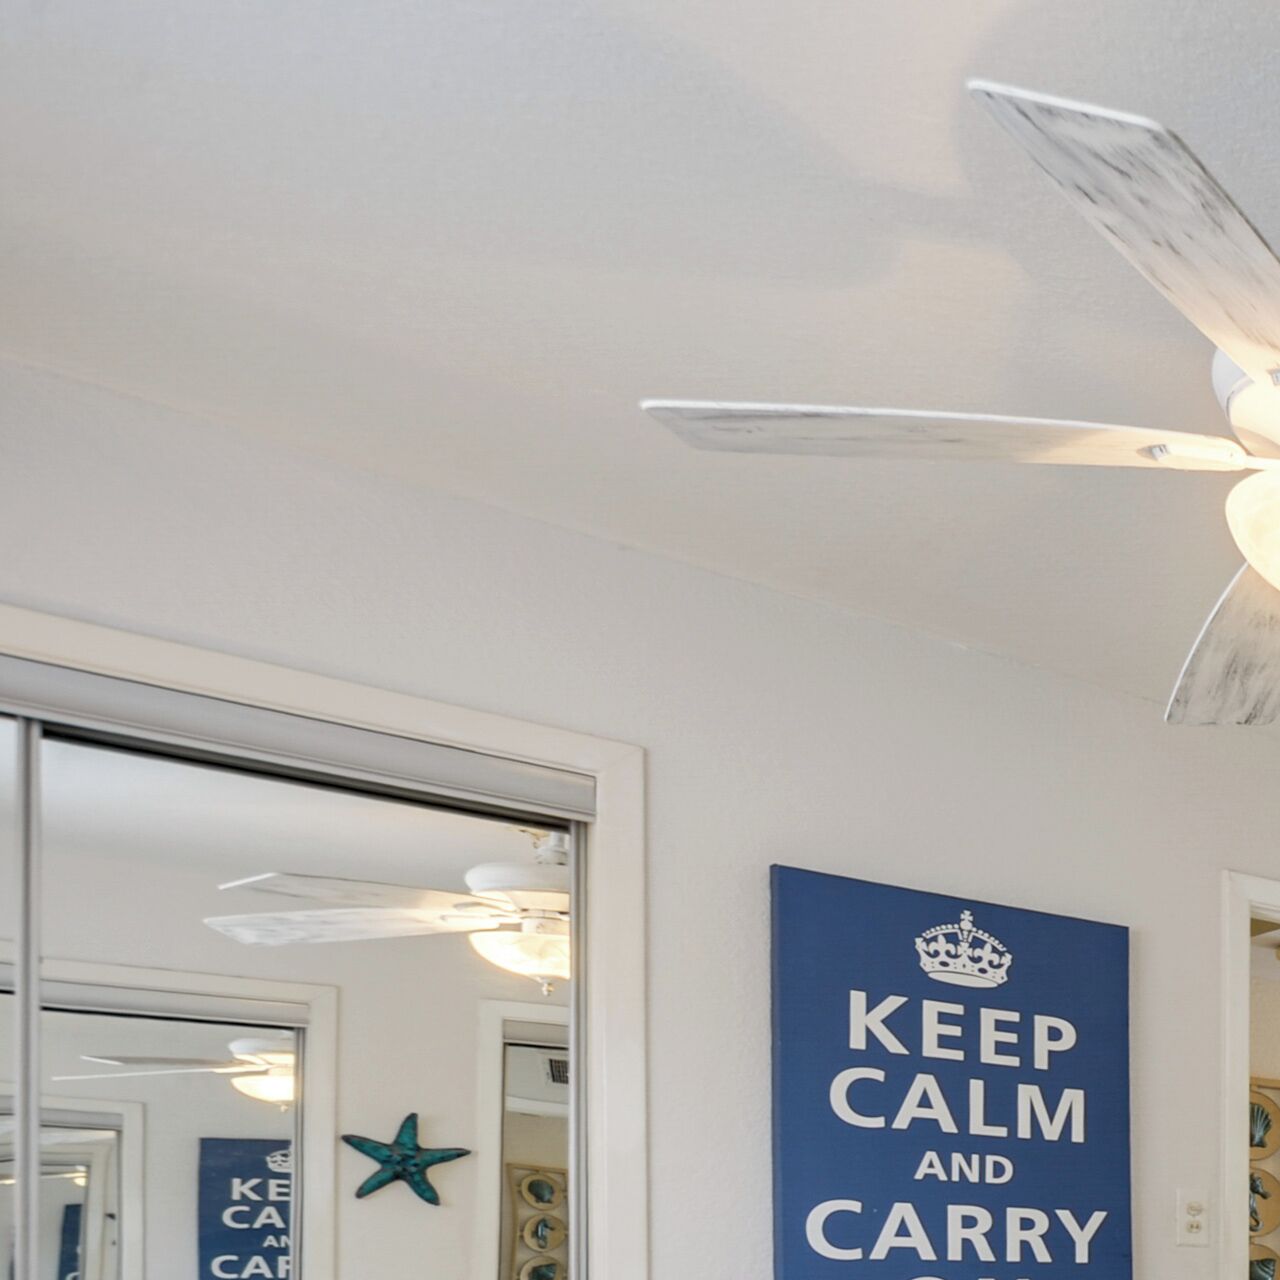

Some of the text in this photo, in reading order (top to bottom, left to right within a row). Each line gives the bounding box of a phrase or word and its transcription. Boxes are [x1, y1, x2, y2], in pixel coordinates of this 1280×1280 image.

[848, 989, 1077, 1070] KEEP
[829, 1066, 1085, 1144] CALM
[913, 1150, 1014, 1184] AND
[804, 1198, 1108, 1264] CARRY
